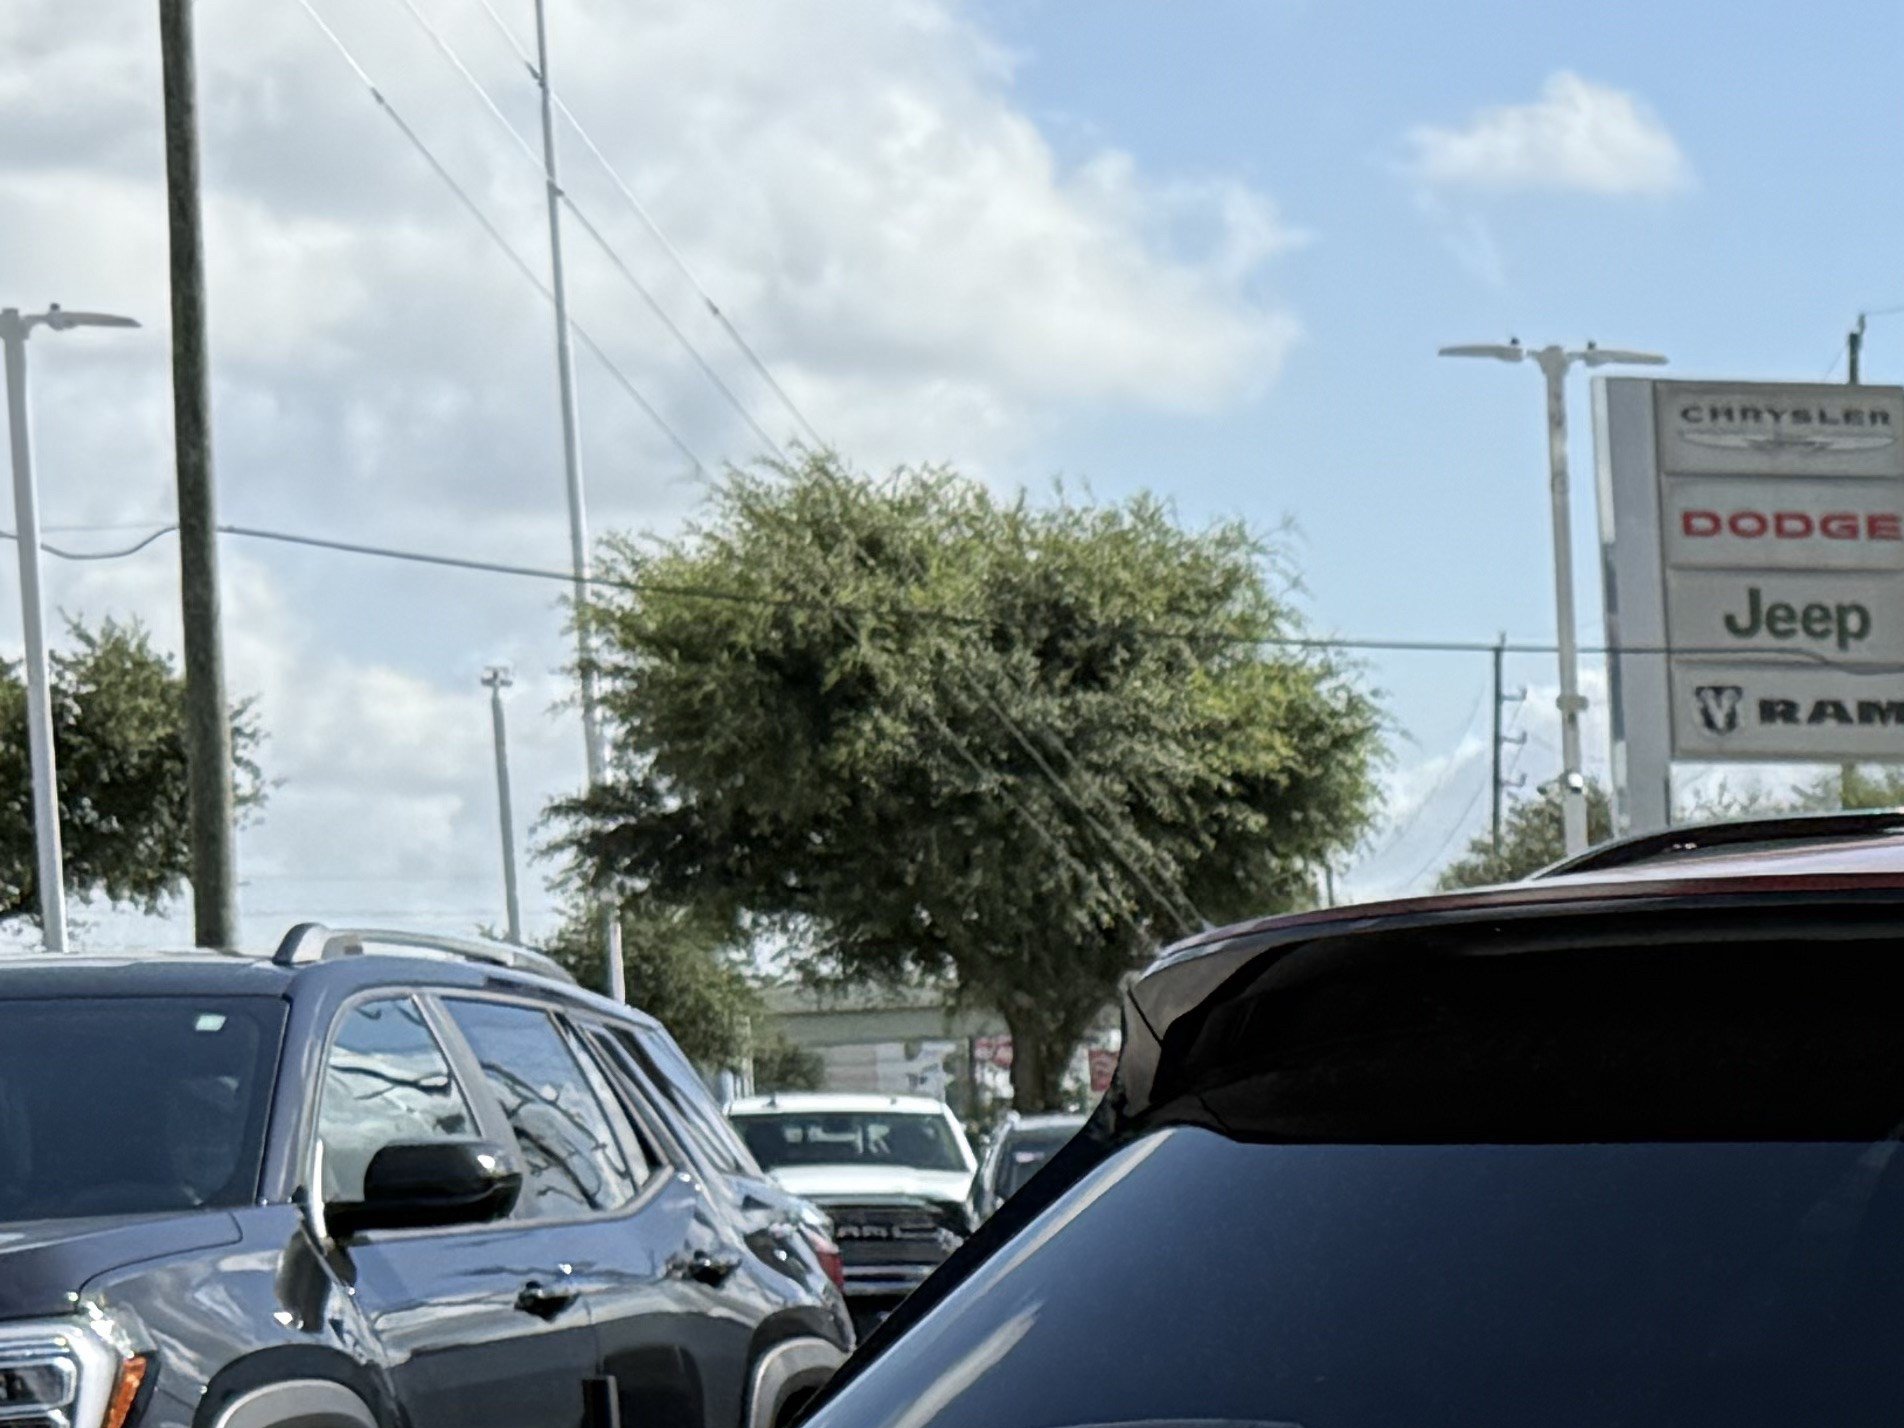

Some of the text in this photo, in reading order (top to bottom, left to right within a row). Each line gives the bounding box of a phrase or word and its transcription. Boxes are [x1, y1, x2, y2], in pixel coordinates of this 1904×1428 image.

[1680, 405, 1891, 426] CHRYSLER
[1680, 510, 1903, 541] DODGE
[1724, 586, 1871, 650] Jeep
